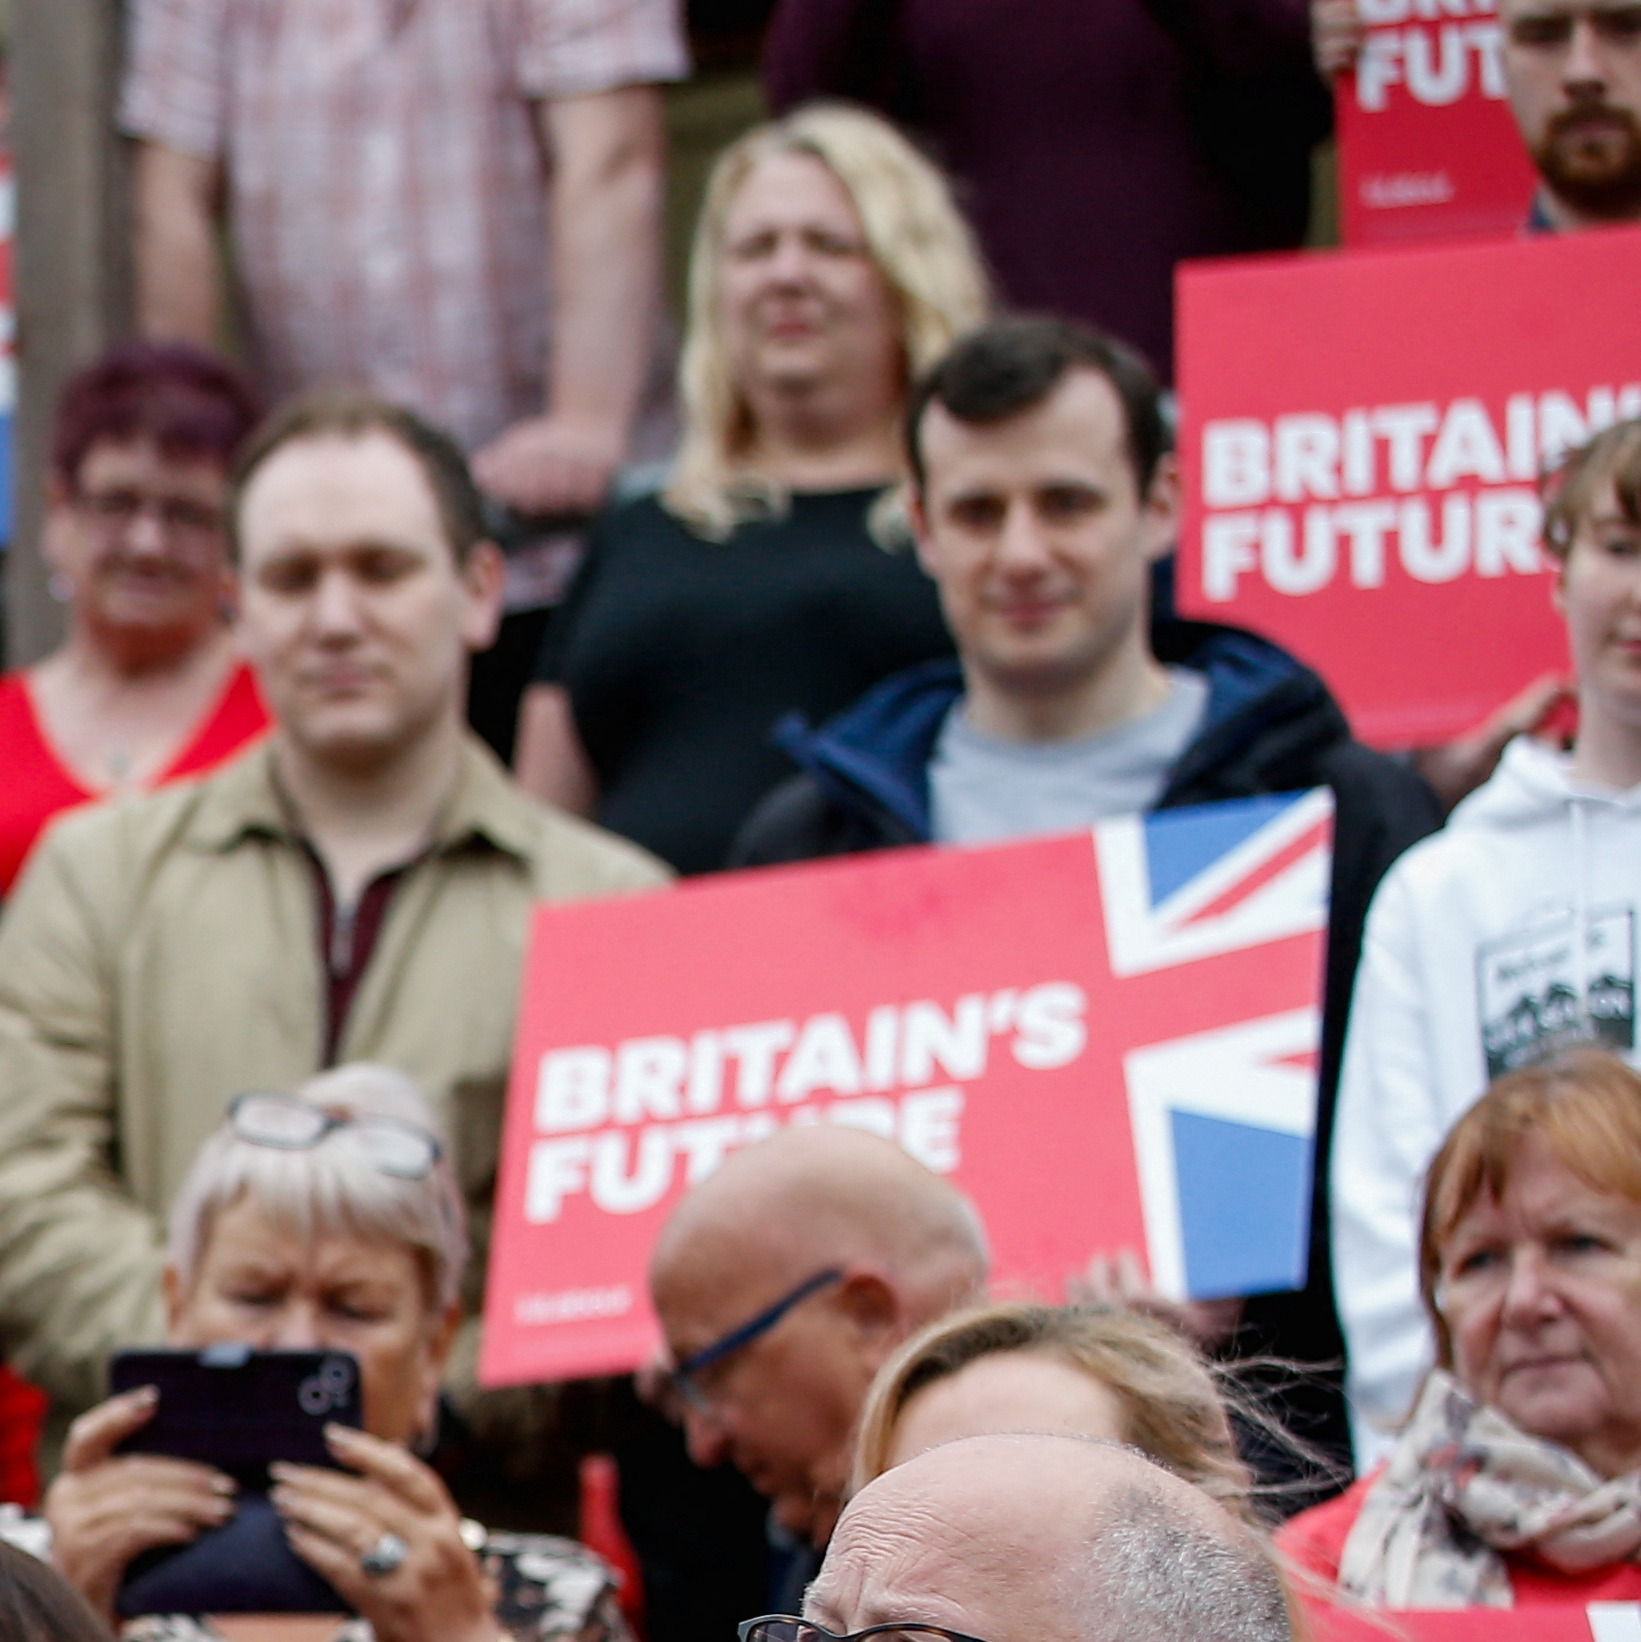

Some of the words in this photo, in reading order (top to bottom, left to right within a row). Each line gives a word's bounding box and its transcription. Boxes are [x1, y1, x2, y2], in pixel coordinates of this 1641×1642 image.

[1357, 23, 1504, 112] FUT
[1202, 487, 1551, 602] FUTUR
[532, 981, 1089, 1135] BRITAIN'S
[523, 1084, 967, 1226] FUTE
